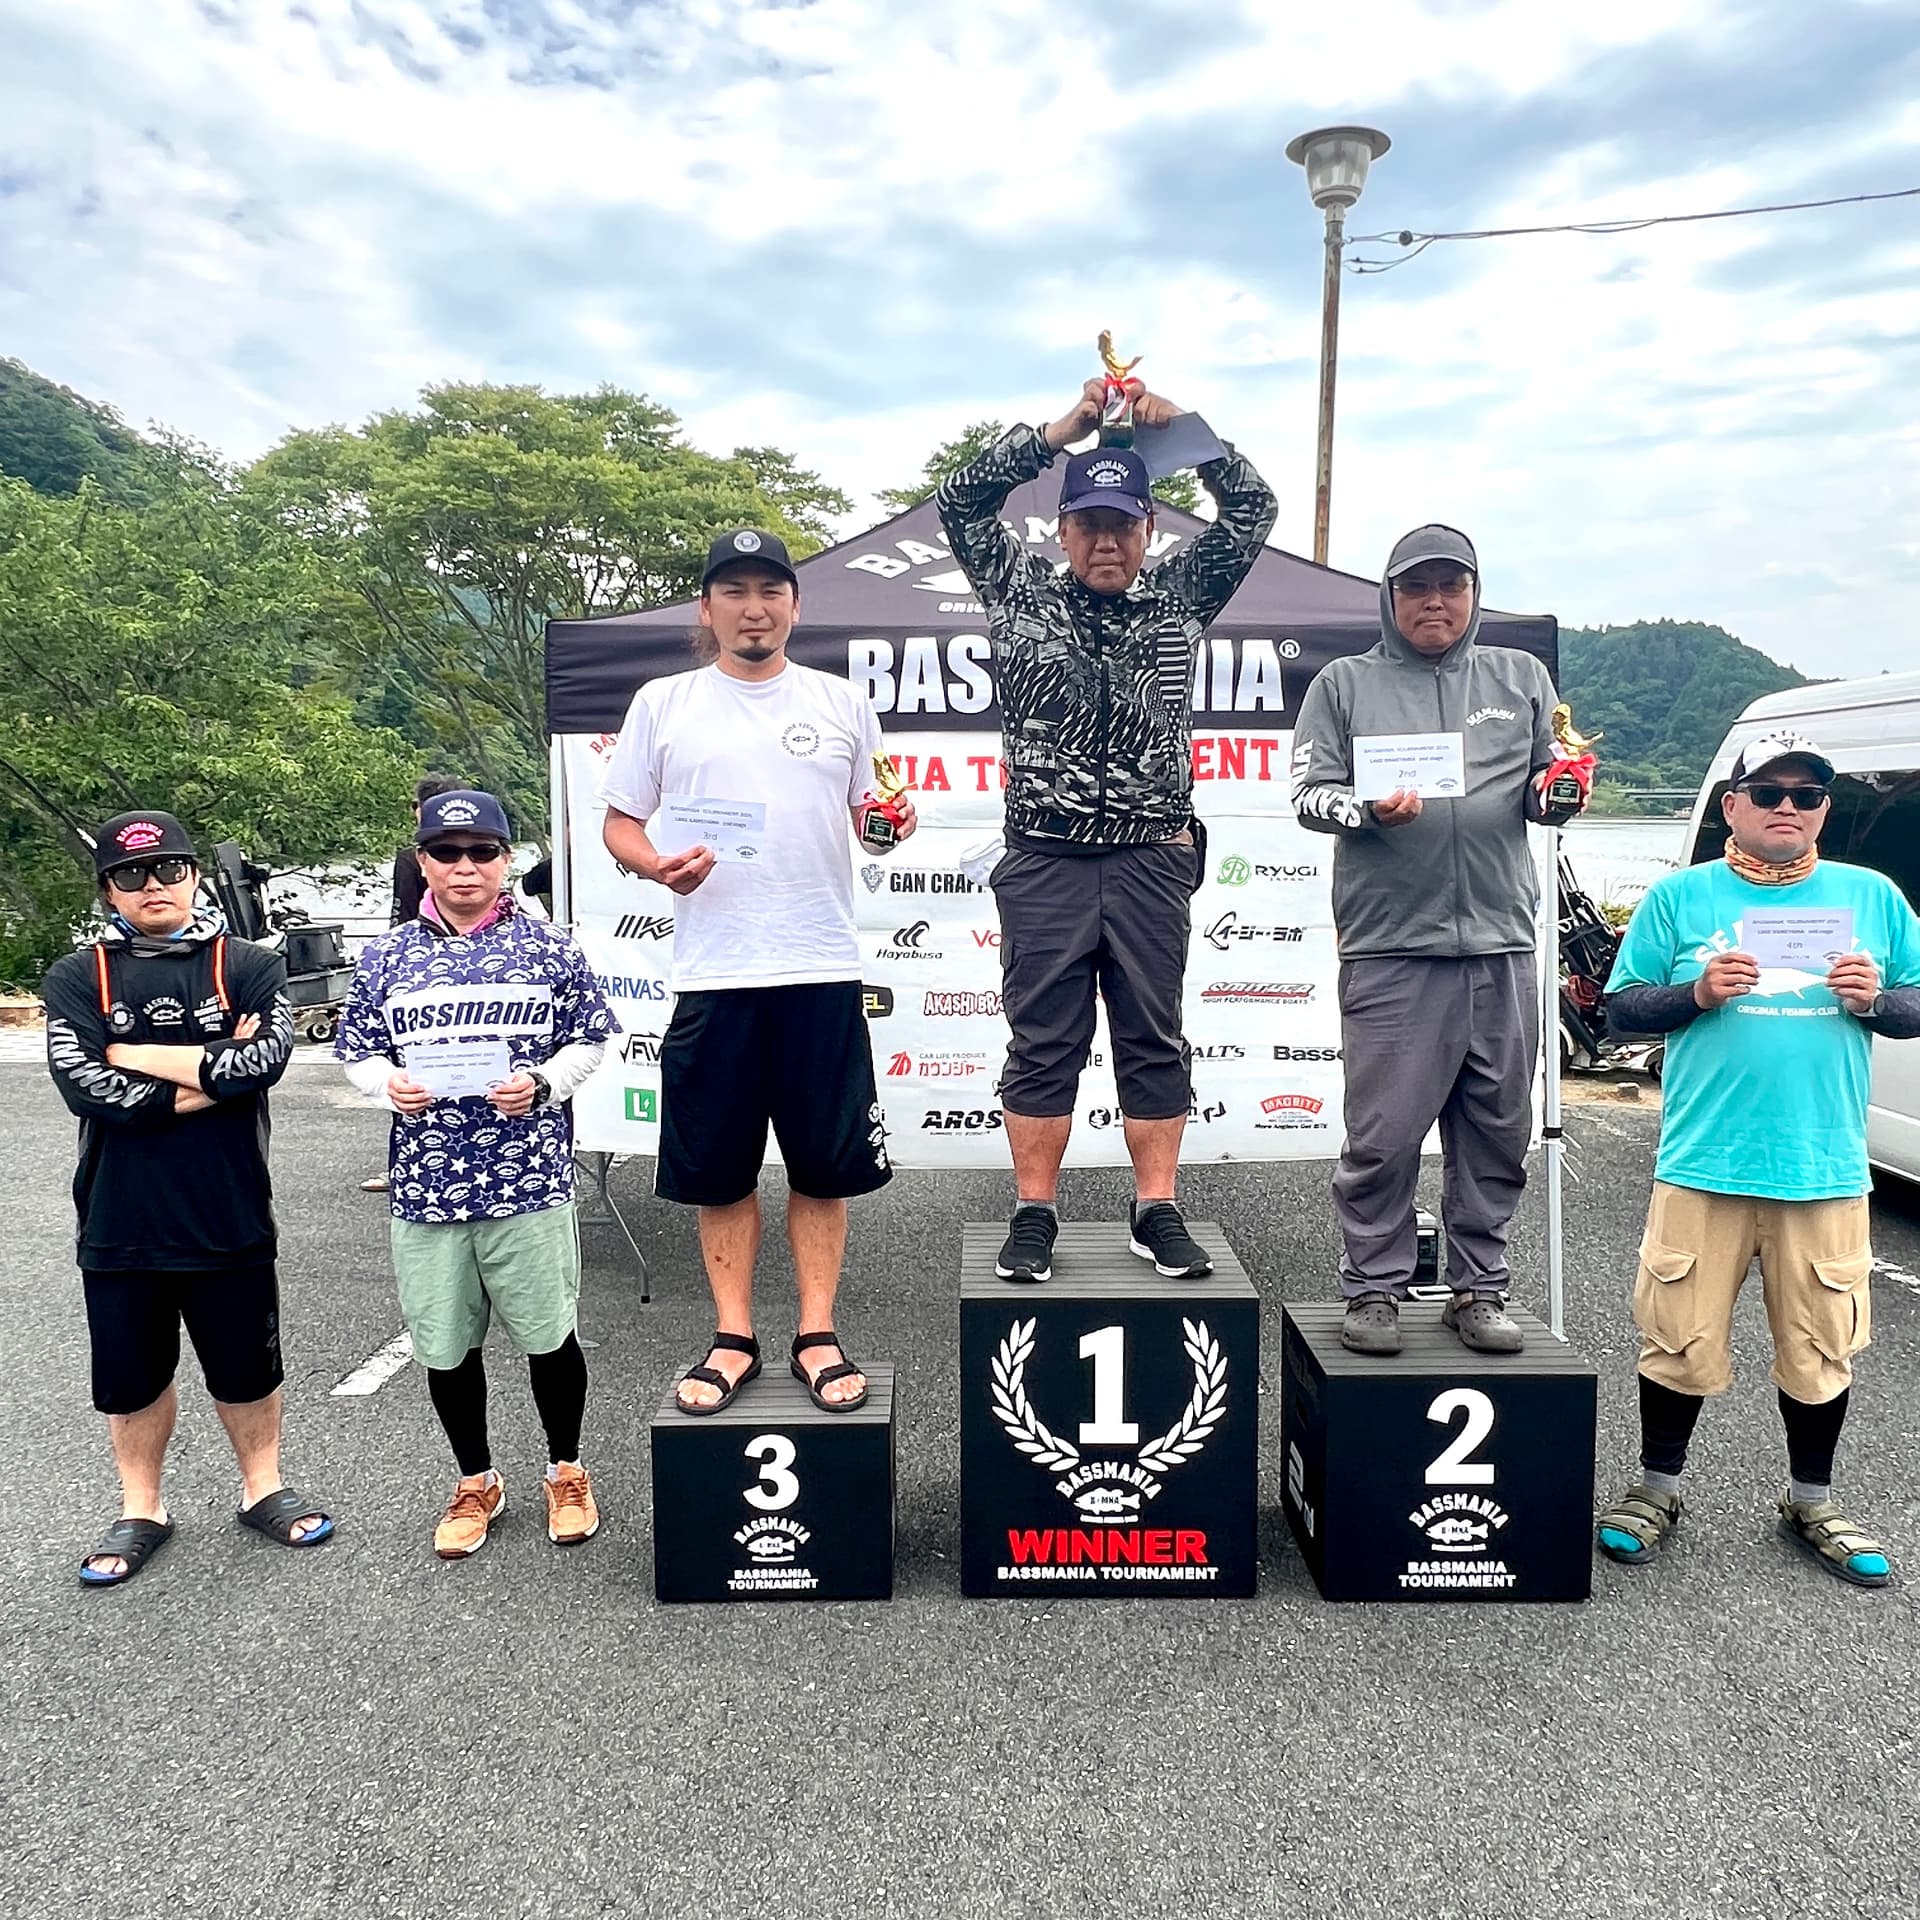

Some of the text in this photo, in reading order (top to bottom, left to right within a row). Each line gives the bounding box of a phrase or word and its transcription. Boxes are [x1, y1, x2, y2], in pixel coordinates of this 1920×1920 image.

[1255, 865, 1318, 876] RYUGI
[890, 873, 925, 893] GAN
[876, 949, 943, 960] Hayabusa
[924, 991, 976, 1016] AKASHI
[1737, 1005, 1839, 1016] ORIGINAL FISHING CLUB
[392, 996, 549, 1035] Bassmania
[1079, 1326, 1139, 1444] 1
[1425, 1388, 1495, 1484] 2
[742, 1434, 800, 1511] 3
[1055, 1461, 1162, 1500] BASSMANIA
[1408, 1493, 1509, 1529] BASSMANIA
[733, 1516, 811, 1544] BASSMANIA
[1008, 1529, 1208, 1563] WINNER
[734, 1568, 811, 1579] BASSMANIA
[998, 1566, 1219, 1580] BASSMANIA TOURNAMENT
[1407, 1561, 1508, 1574] BASSMANIA
[727, 1578, 819, 1590] TOURNAMENT
[1398, 1574, 1517, 1588] TOURNAMENT
